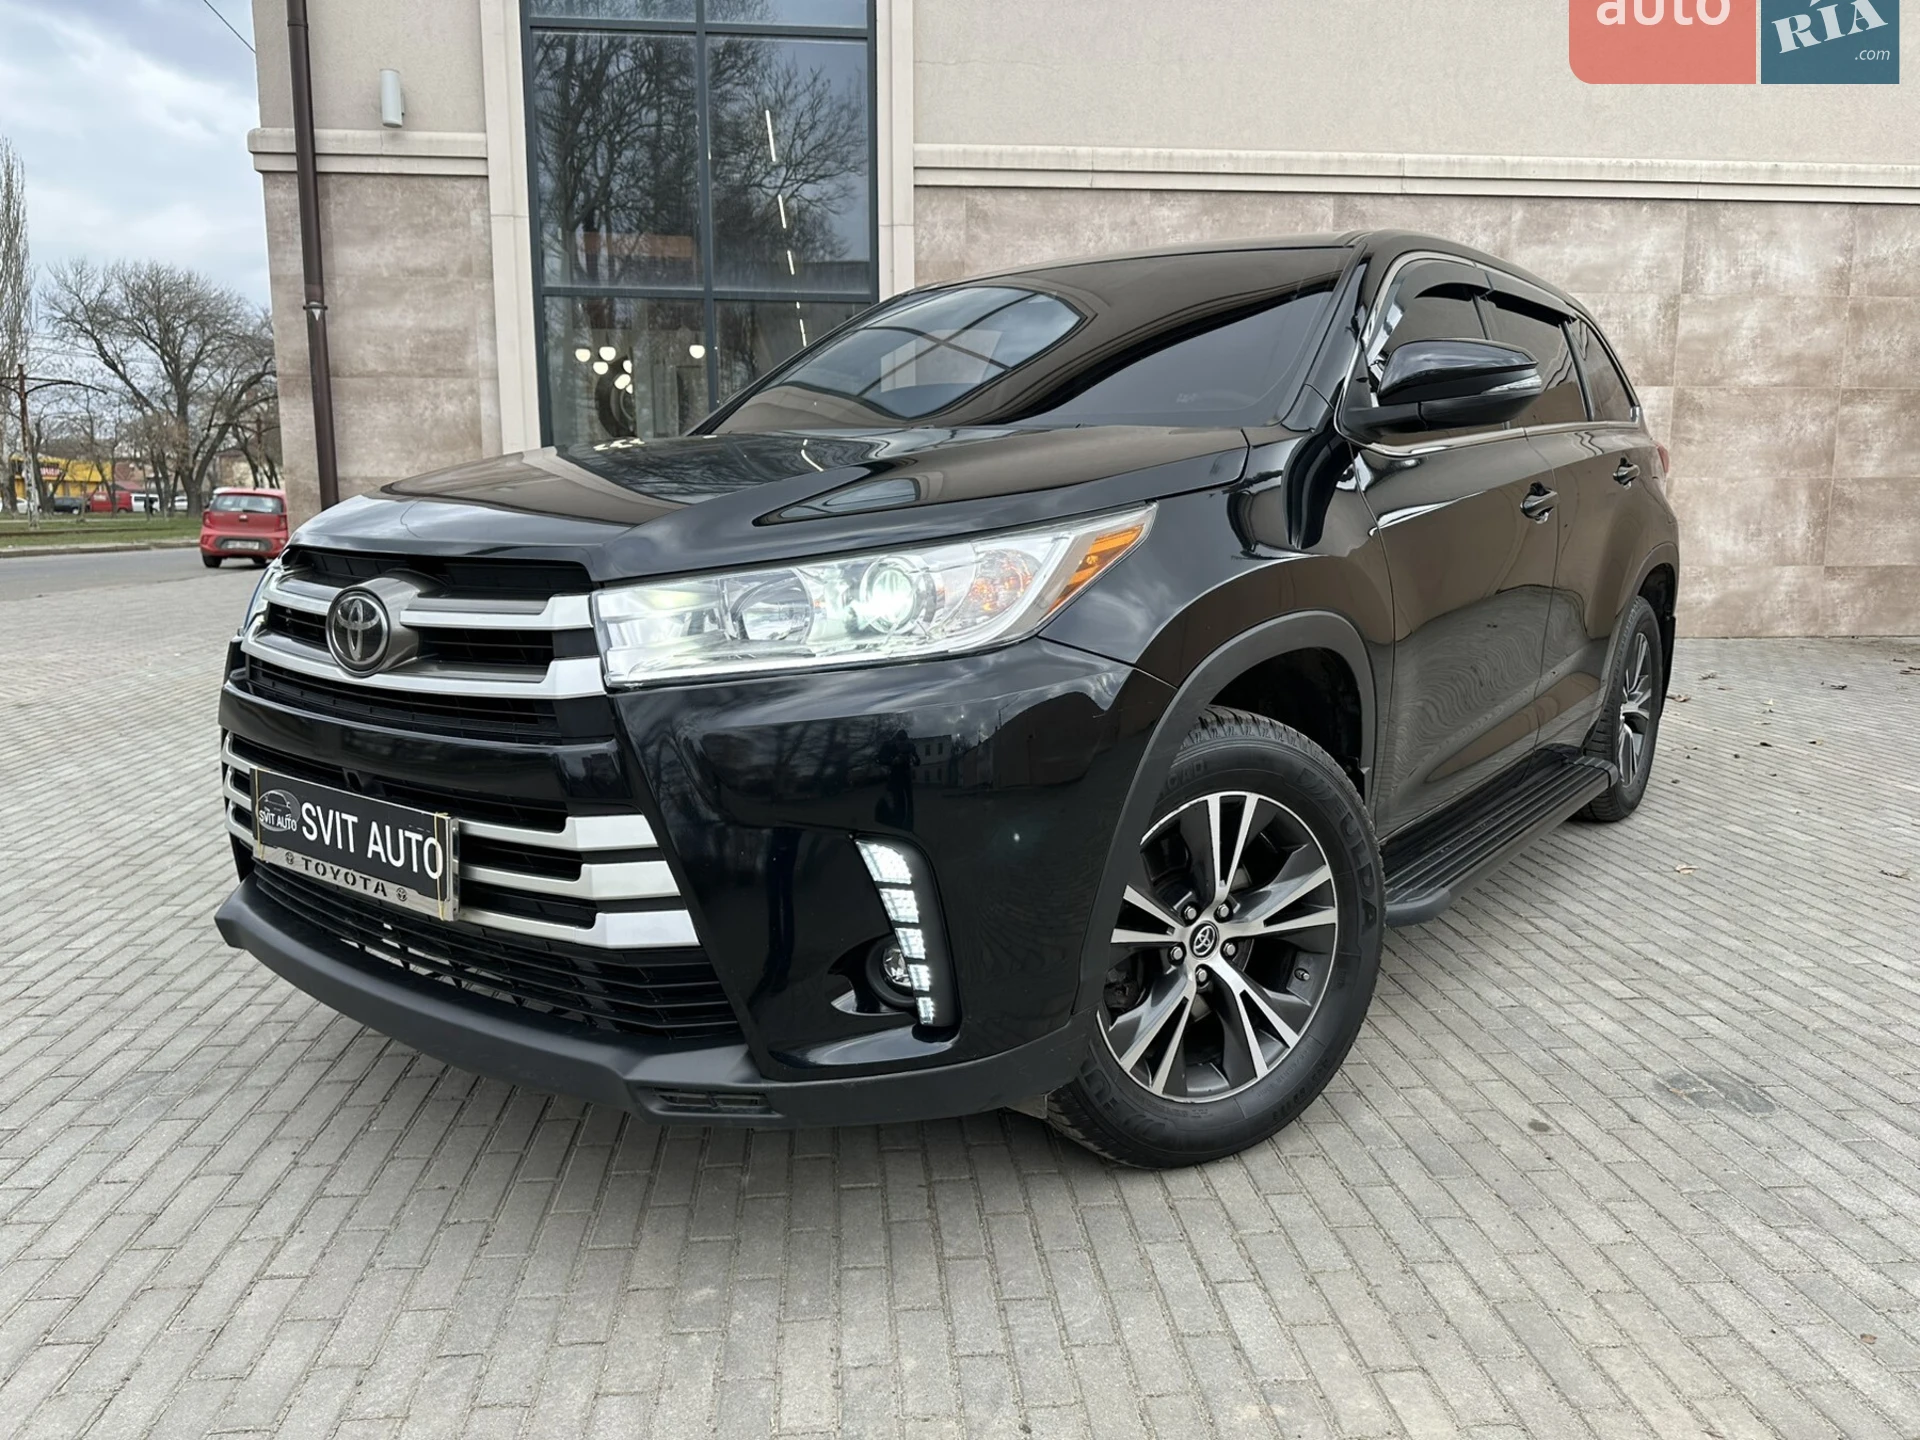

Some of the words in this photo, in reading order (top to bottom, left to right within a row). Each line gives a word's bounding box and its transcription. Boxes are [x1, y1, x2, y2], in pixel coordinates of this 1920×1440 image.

[301, 802, 358, 853] SVIT
[367, 821, 443, 879] AUTO
[301, 856, 387, 897] TOYOTA
